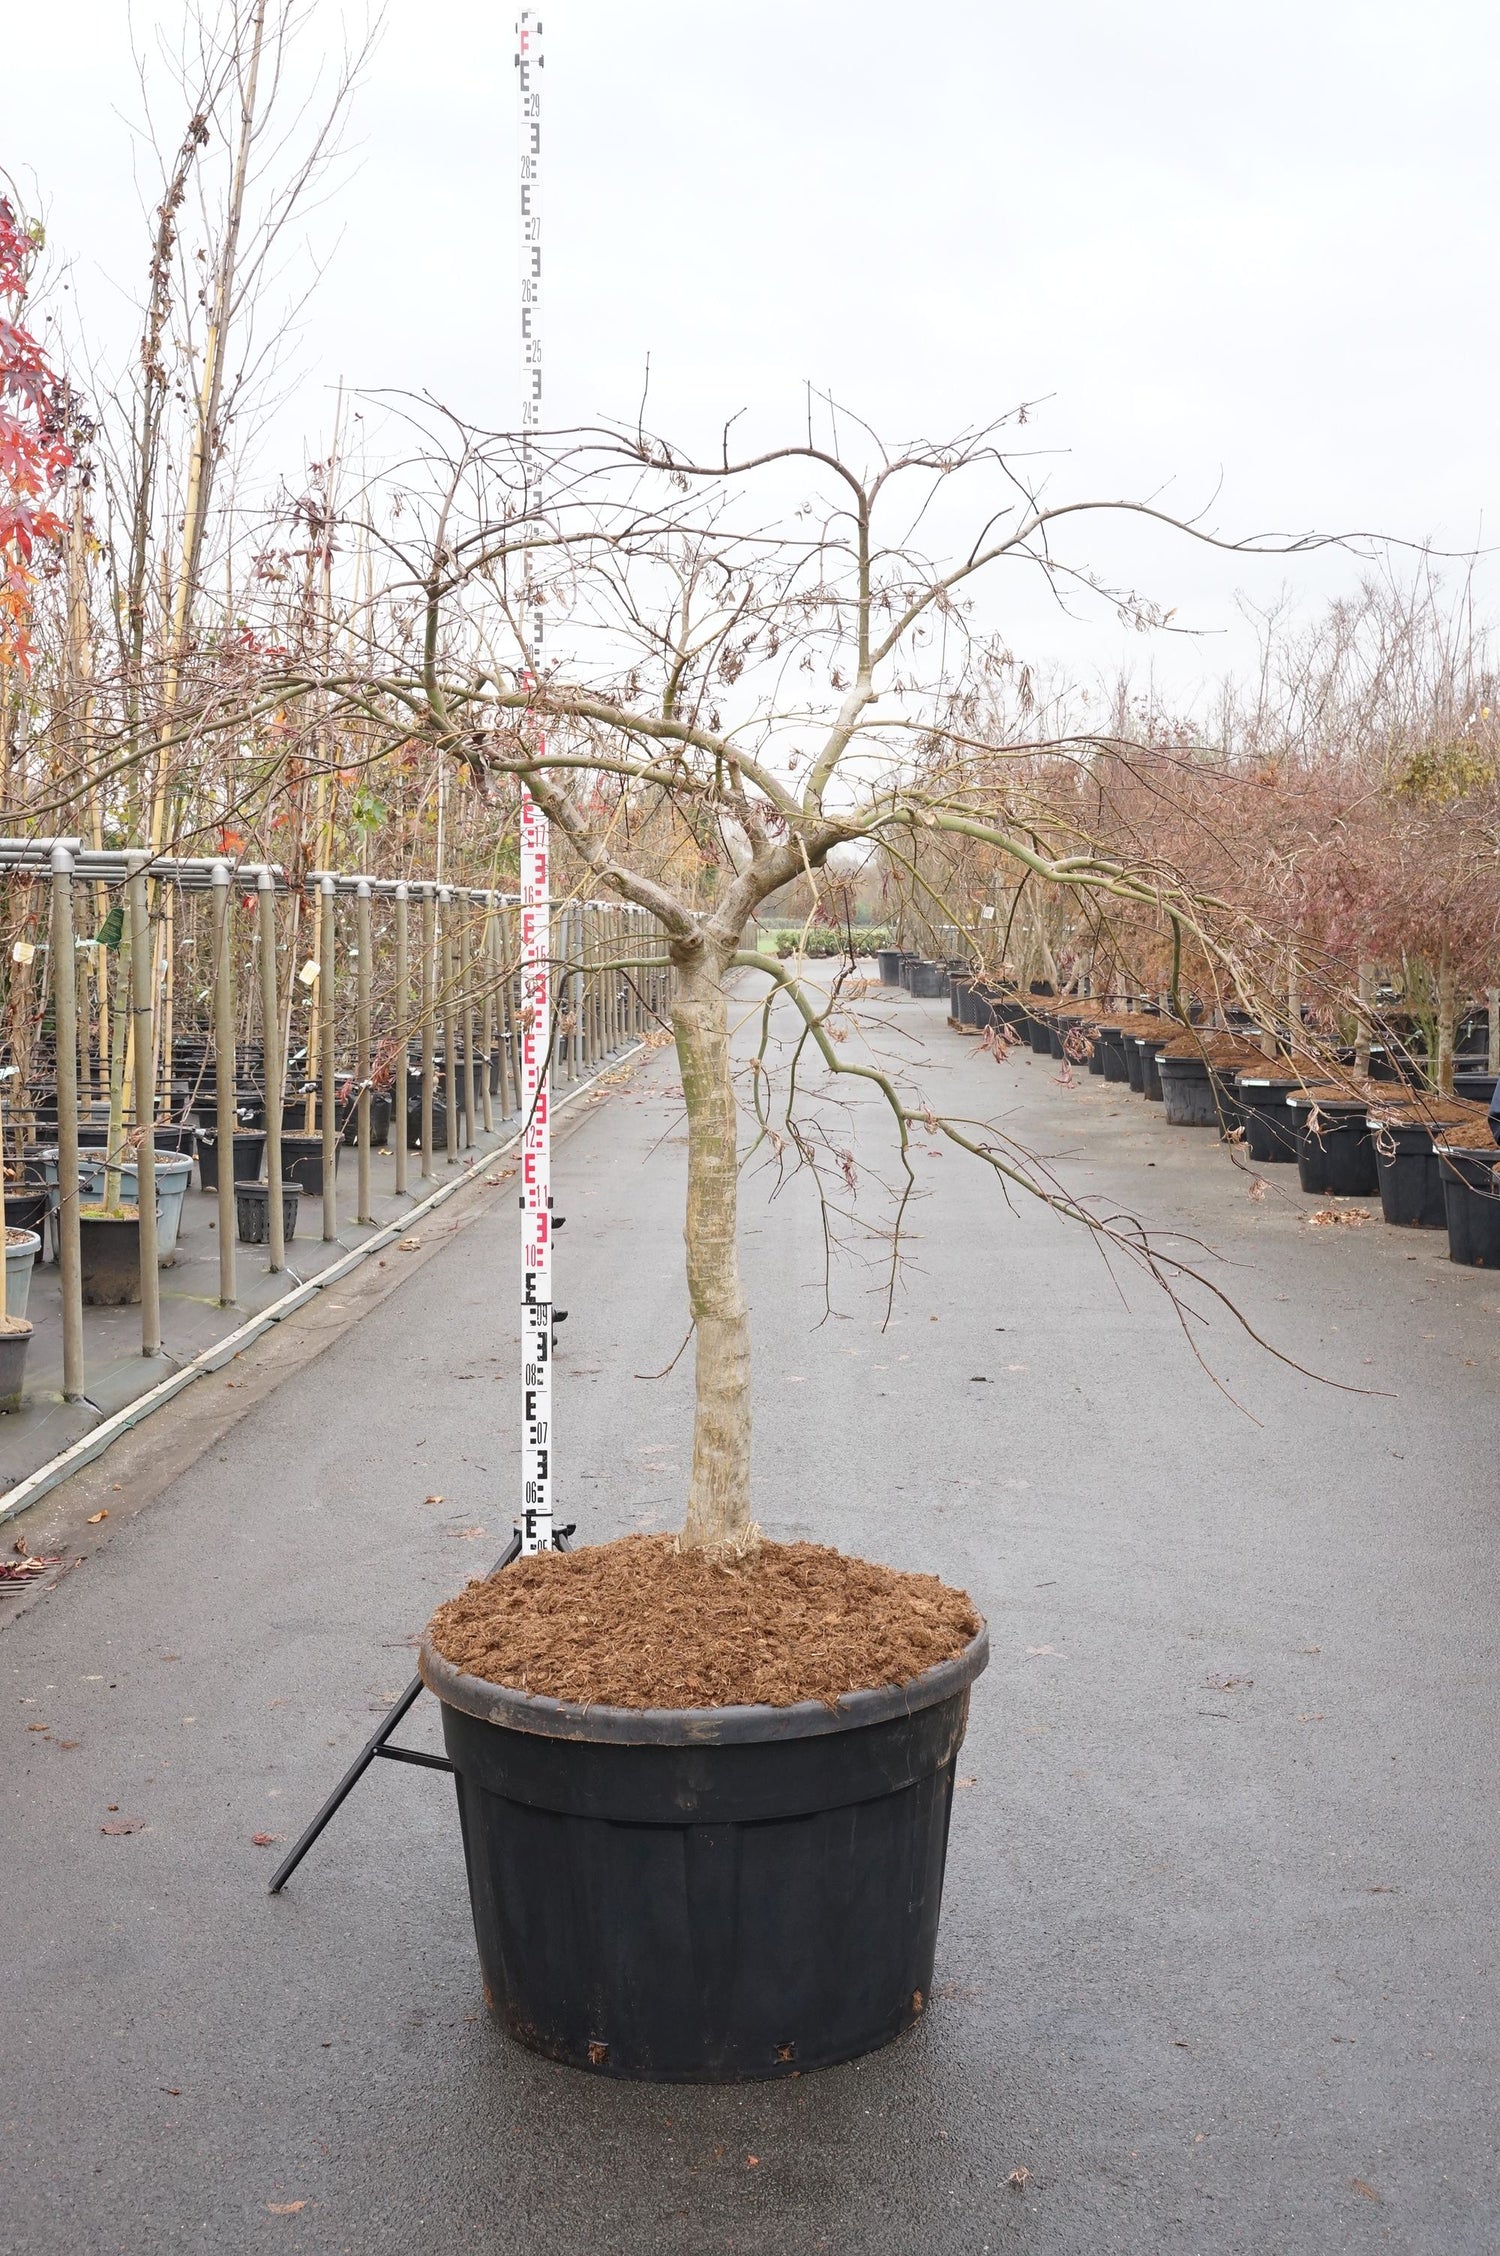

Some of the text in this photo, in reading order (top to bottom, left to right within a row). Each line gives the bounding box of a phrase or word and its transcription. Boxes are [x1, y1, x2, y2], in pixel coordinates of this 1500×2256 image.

[530, 93, 540, 117] 29
[521, 155, 531, 179] 28
[531, 217, 541, 241] 27
[522, 279, 531, 303] 26
[532, 339, 542, 363] 25
[523, 401, 532, 425] 24
[535, 825, 545, 848] 17
[524, 885, 534, 909] 16
[535, 945, 546, 968] 15
[525, 1125, 535, 1148] 12
[537, 1184, 548, 1208] 11
[526, 1244, 537, 1268] 10
[526, 1363, 536, 1386] 08
[537, 1421, 548, 1445] 07
[526, 1481, 536, 1504] 06
